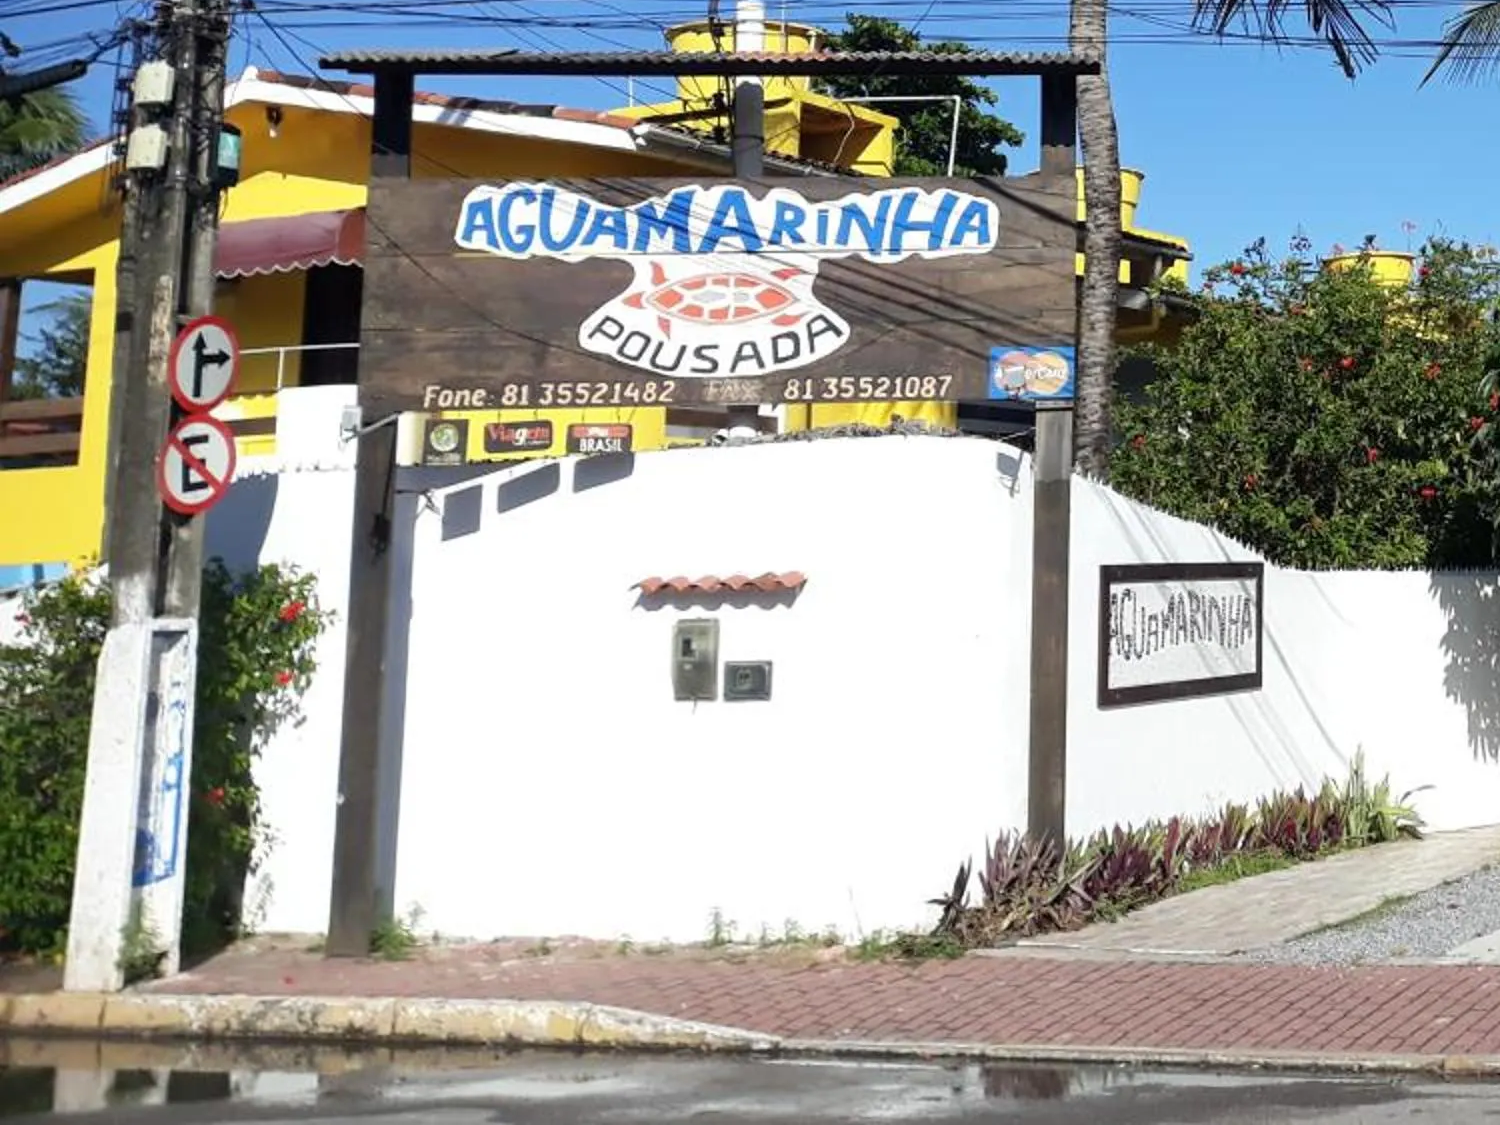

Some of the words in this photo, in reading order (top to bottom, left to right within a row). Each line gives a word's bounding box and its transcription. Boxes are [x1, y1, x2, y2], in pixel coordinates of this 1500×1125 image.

[587, 313, 844, 374] POUSADA
[501, 383, 529, 406] 81
[538, 380, 676, 405] 35521482
[783, 377, 813, 400] 81
[821, 375, 953, 399] 35521087
[182, 435, 209, 493] E
[579, 438, 623, 452] BRASIL
